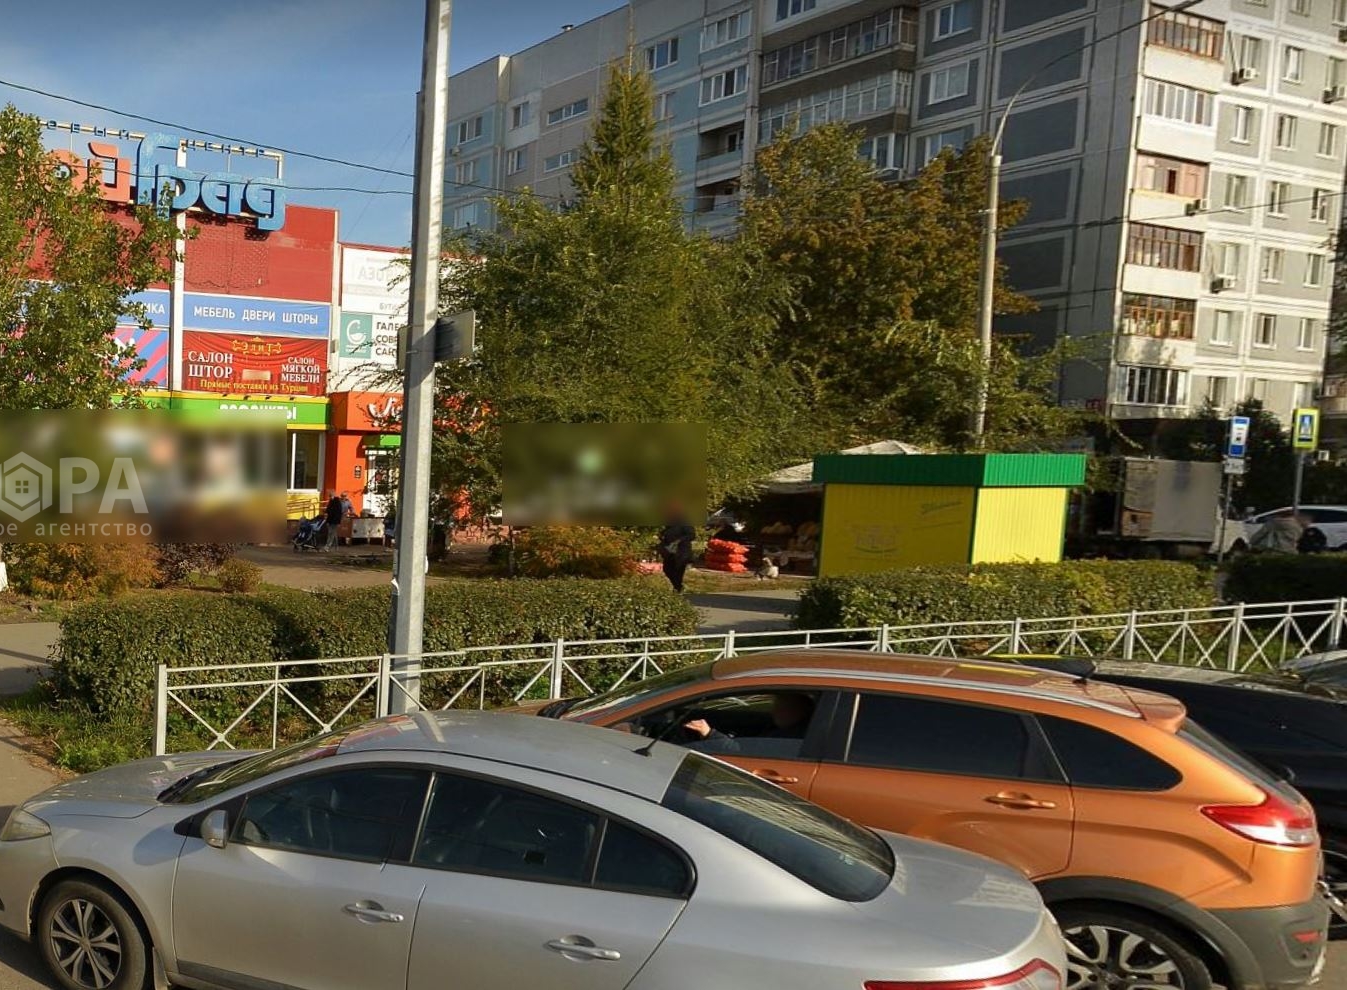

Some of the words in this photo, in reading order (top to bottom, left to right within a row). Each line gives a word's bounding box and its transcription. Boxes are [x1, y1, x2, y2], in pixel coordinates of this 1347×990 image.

[193, 305, 235, 319] МЕБЕЛЬ
[242, 308, 276, 323] ДВЕРИ
[282, 312, 318, 325] ШТОРЫ
[188, 350, 233, 364] САЛОН
[287, 356, 315, 365] САЛОН
[188, 364, 233, 378] ШТОР
[281, 364, 320, 374] МЯГКОЙ
[281, 373, 320, 383] МЕБЕЛИ
[200, 379, 232, 390] Прямые
[234, 381, 267, 391] поставки
